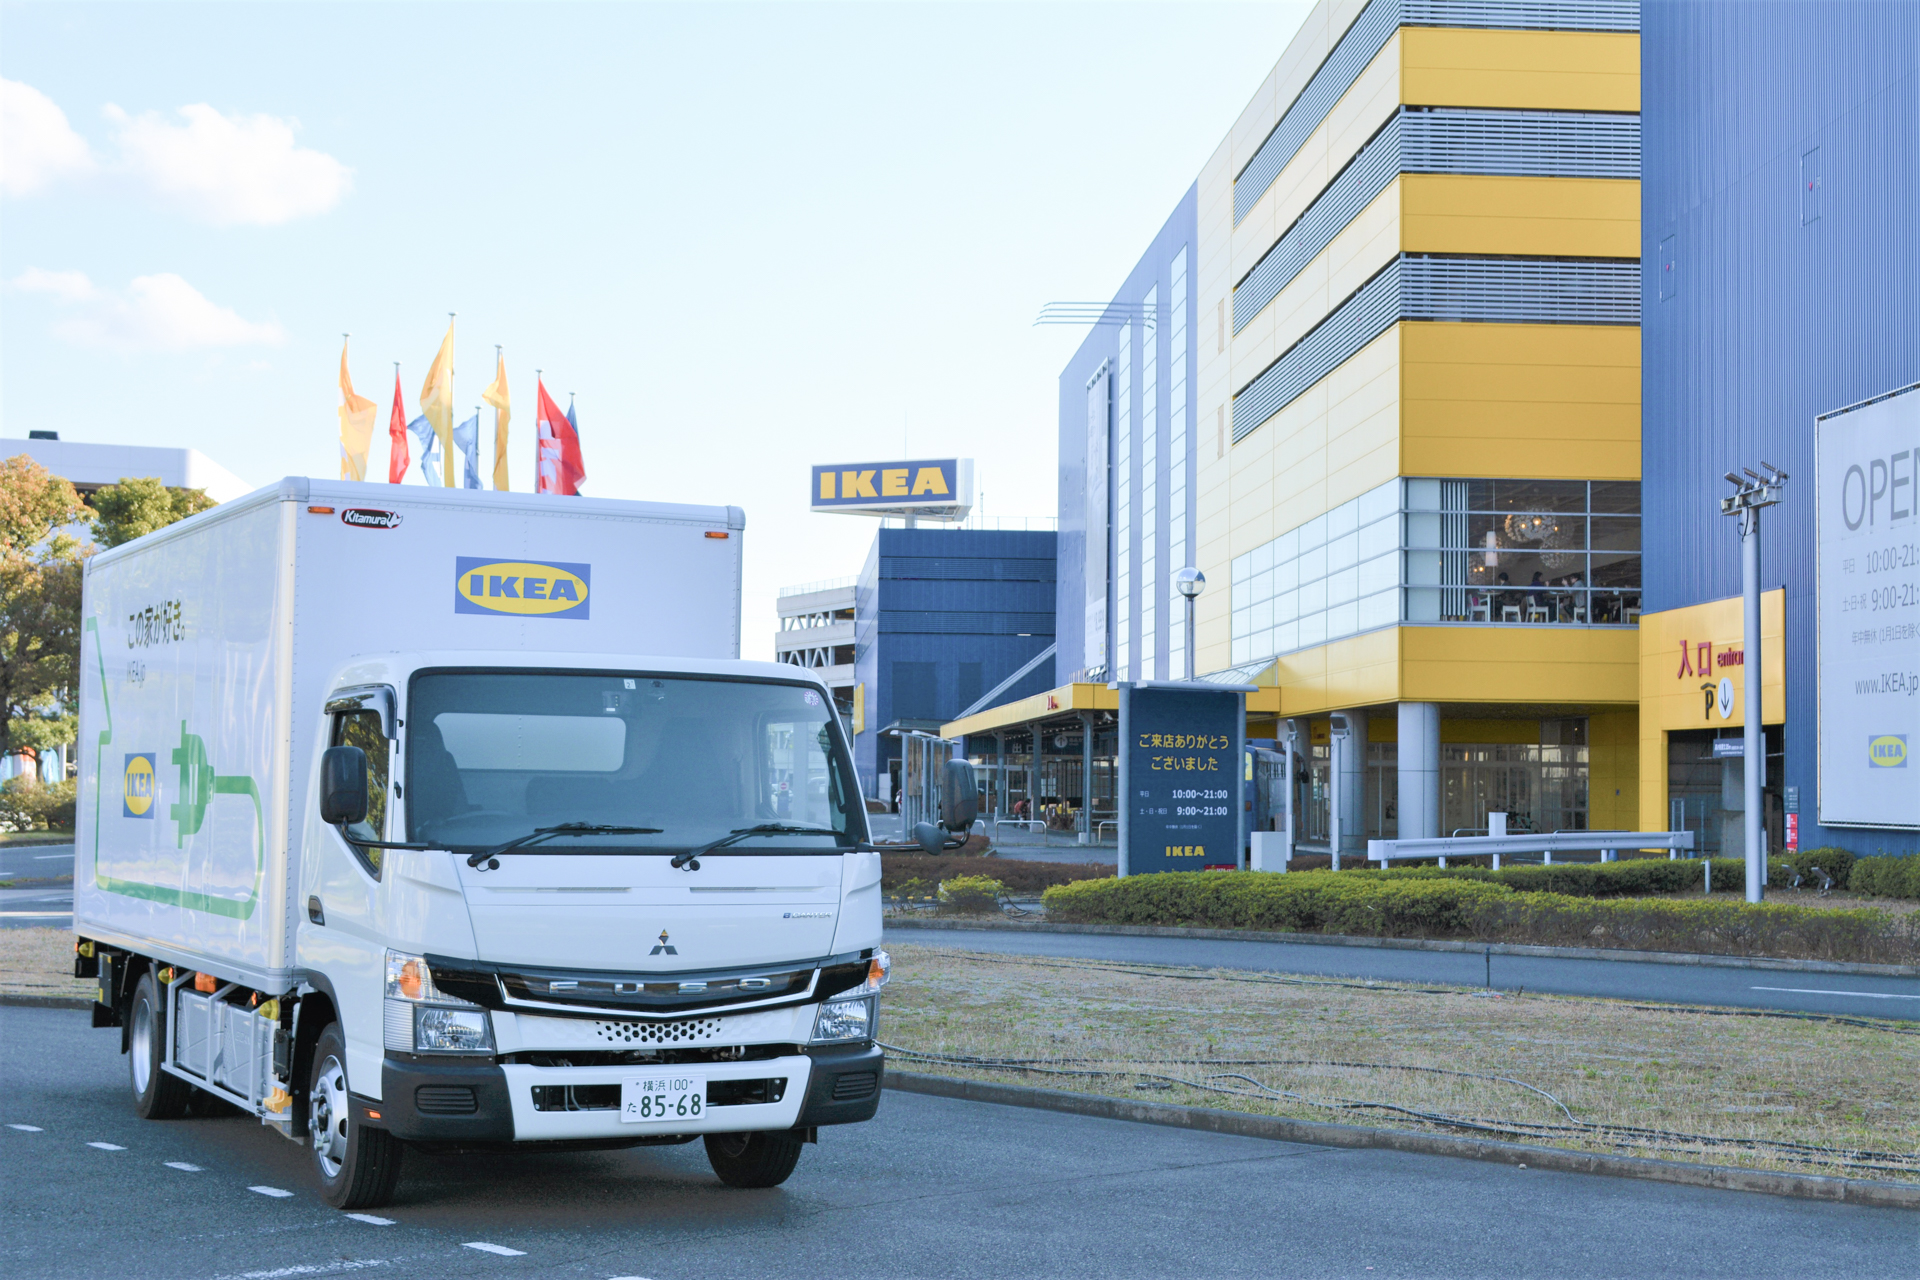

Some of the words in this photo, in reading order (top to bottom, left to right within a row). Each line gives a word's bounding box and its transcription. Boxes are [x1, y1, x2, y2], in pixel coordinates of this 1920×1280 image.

[820, 467, 949, 499] IKEA
[344, 510, 387, 525] Kitamura
[470, 574, 579, 601] IKEA
[128, 599, 186, 650] この家が好き。
[1677, 640, 1712, 679] 入口
[1855, 671, 1919, 696] www.IKEA.jp
[1139, 733, 1229, 749] ご来店ありがとう
[1873, 744, 1903, 758] IKEA
[1151, 756, 1218, 771] ございました
[127, 773, 152, 797] IKEA
[1165, 846, 1205, 857] IKEA
[549, 978, 771, 996] FUSO
[627, 1102, 637, 1113] た
[641, 1093, 702, 1118] 85-68
